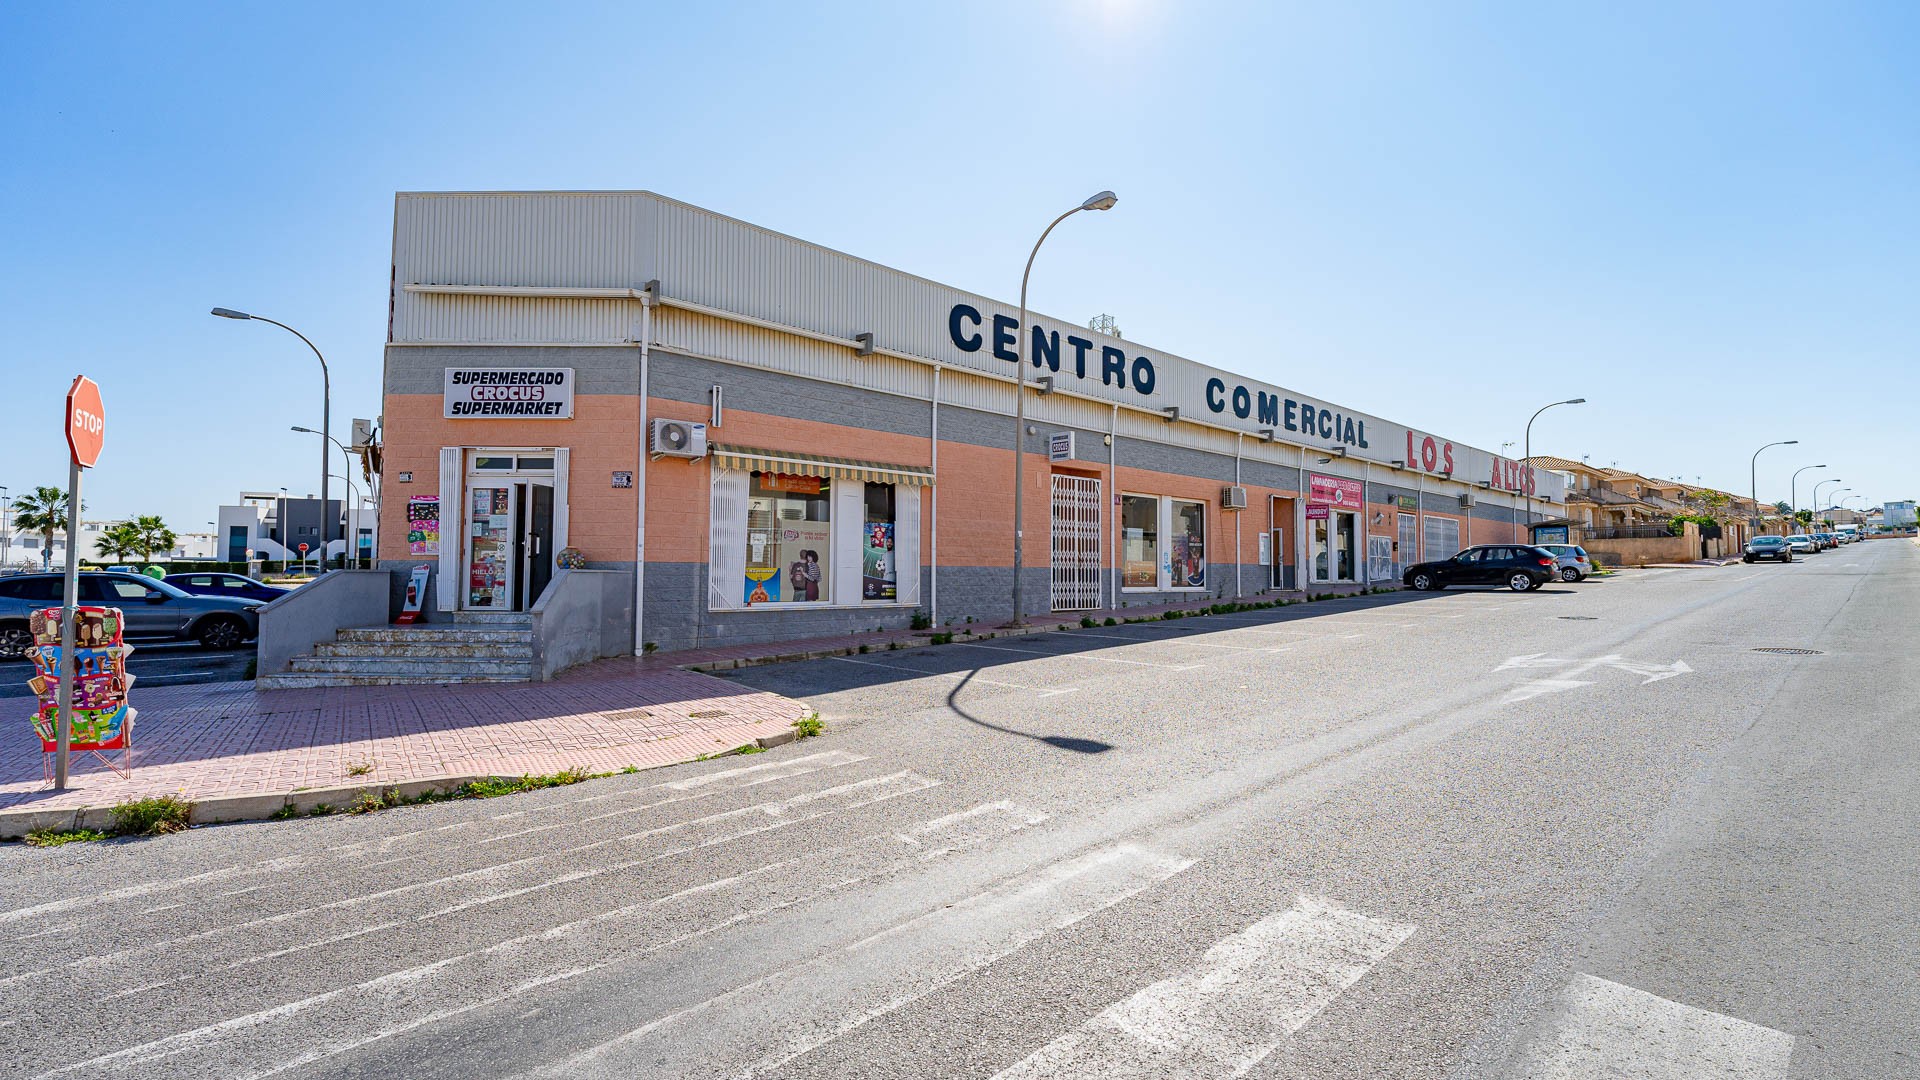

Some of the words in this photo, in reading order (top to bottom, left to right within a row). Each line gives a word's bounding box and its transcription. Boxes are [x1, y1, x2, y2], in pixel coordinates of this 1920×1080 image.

[452, 371, 564, 385] SUPERMERCADO
[472, 386, 543, 400] CROCUS
[949, 304, 1156, 395] CENTRO
[1206, 377, 1369, 449] COMERCIAL
[1406, 430, 1454, 474] LOS
[1490, 457, 1536, 496] ALTOS
[452, 402, 562, 415] SUPERMARKET
[75, 408, 103, 435] STOP
